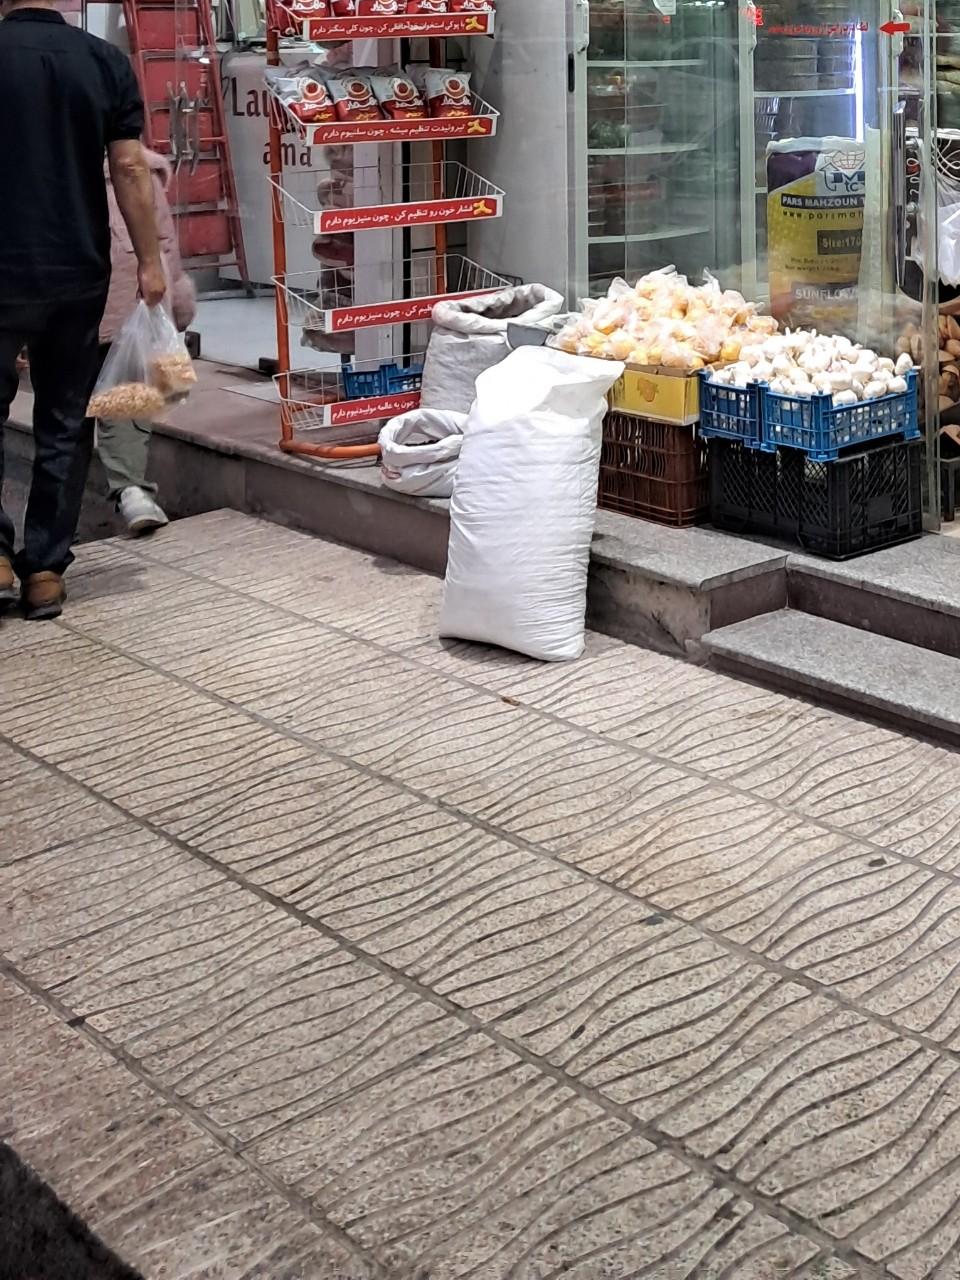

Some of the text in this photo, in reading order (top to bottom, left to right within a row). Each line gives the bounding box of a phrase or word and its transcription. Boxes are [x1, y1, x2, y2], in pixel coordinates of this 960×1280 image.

[312, 25, 327, 36] دارم
[358, 25, 374, 33] چون
[322, 128, 340, 141] دارم
[367, 128, 385, 136] چون
[408, 124, 431, 136] تنظیم
[783, 195, 803, 206] PARS
[805, 195, 858, 207] MAHZOUN
[407, 208, 428, 221] تنظیم
[428, 209, 438, 218] رو
[438, 206, 455, 217] خون
[456, 204, 474, 215] فشار
[325, 216, 342, 228] دارم
[372, 214, 389, 223] چون
[383, 310, 400, 319] چون
[418, 304, 433, 315] ظیم
[337, 314, 353, 326] دارم
[400, 400, 415, 409] چون
[332, 408, 346, 422] دارم
